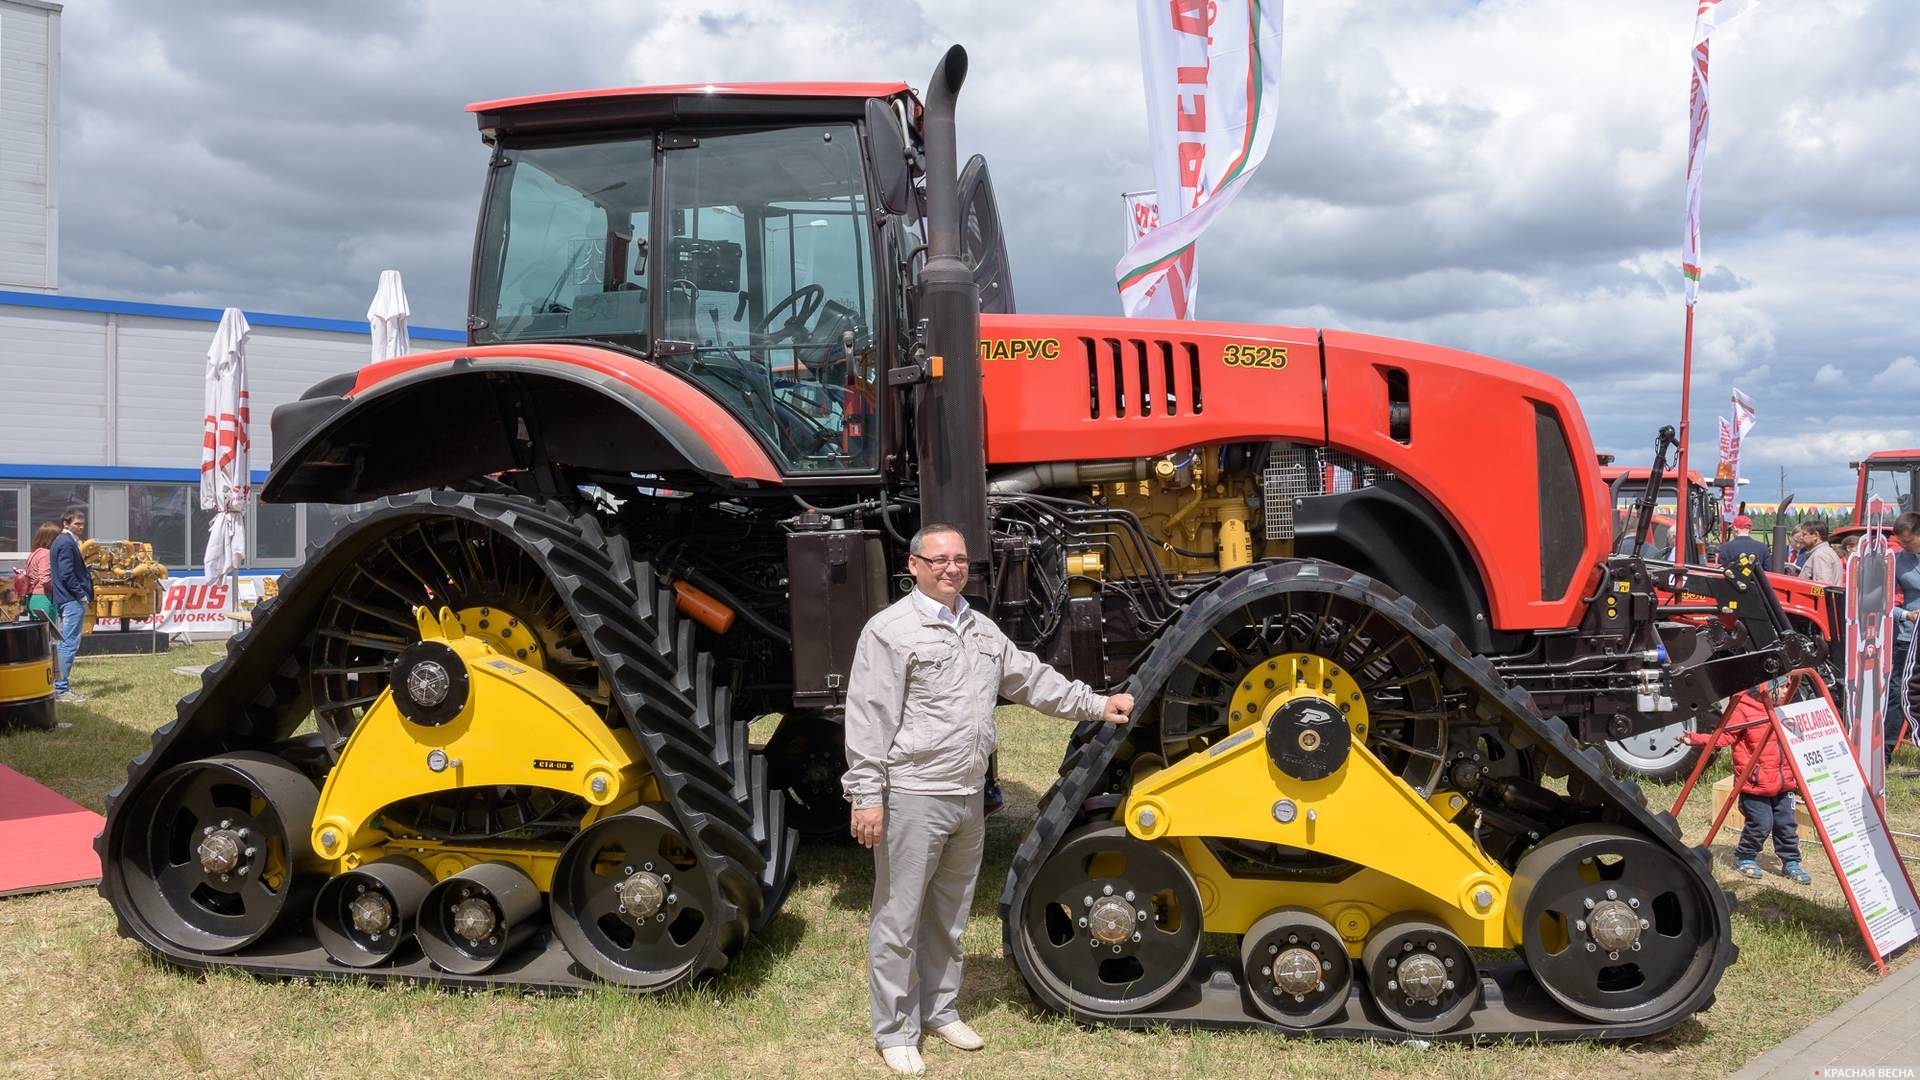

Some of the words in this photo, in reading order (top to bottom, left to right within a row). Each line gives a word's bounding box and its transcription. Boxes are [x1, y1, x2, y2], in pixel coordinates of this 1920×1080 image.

[1222, 344, 1288, 369] 3525
[164, 584, 229, 611] RUS
[173, 612, 226, 623] WORKS
[1795, 708, 1835, 733] BELARUS
[1803, 750, 1824, 767] 3525
